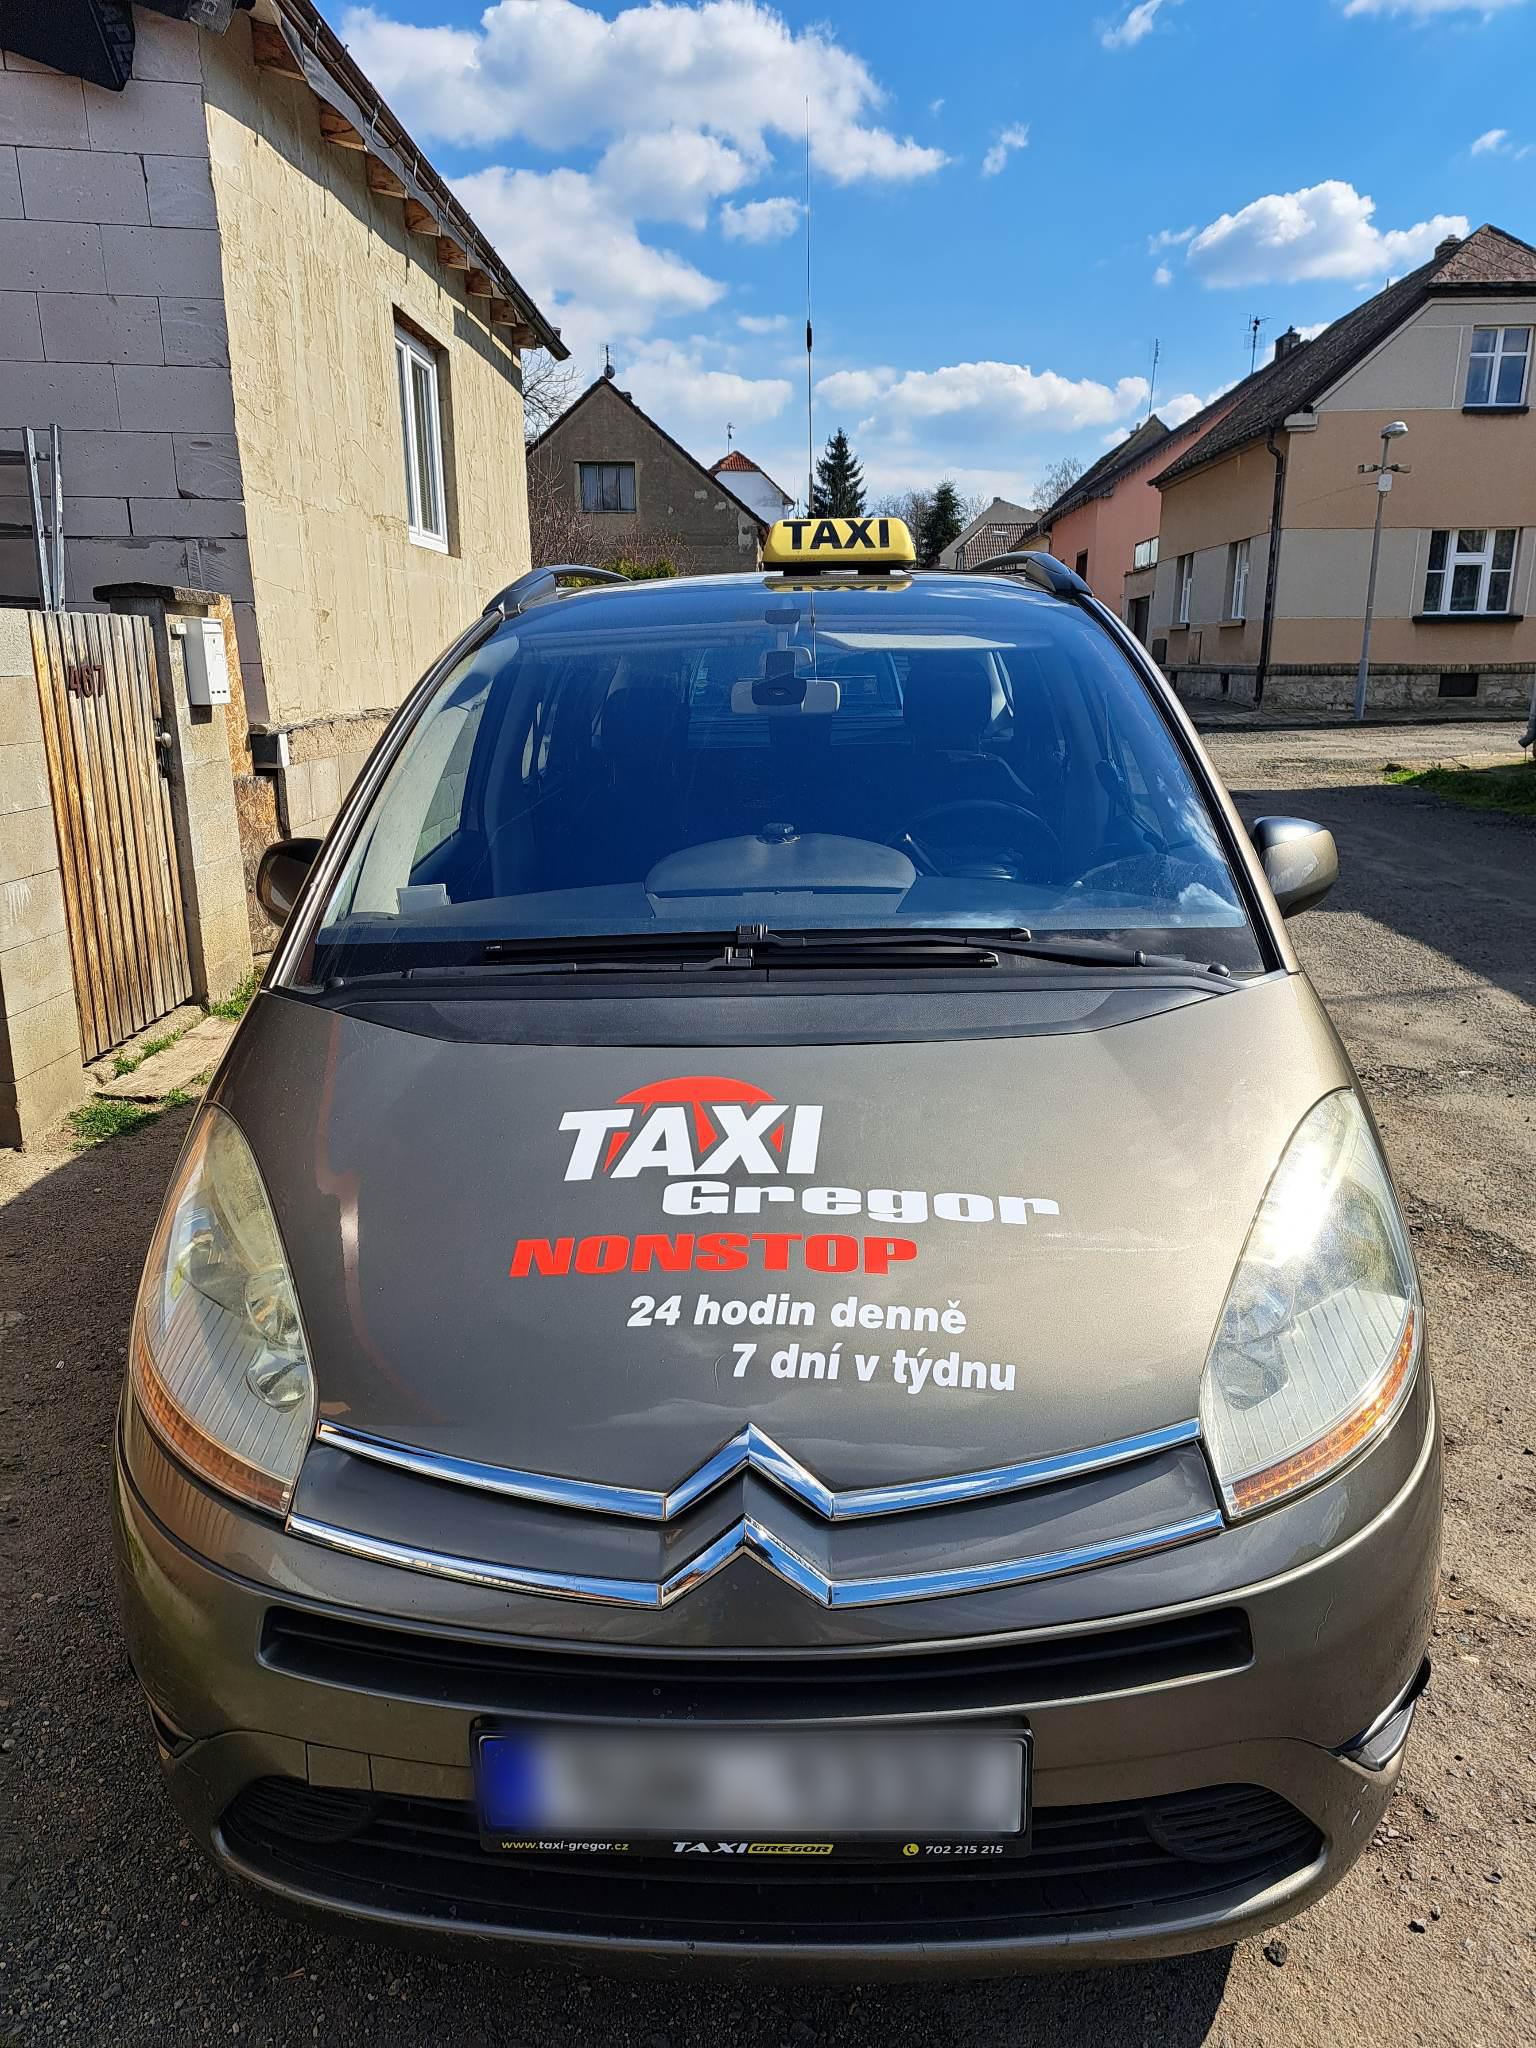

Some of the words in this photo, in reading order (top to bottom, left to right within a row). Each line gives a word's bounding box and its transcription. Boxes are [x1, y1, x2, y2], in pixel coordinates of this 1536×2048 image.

[783, 519, 890, 550] TAXI
[68, 663, 105, 699] 467
[558, 1104, 824, 1182] TAXI
[662, 1180, 1061, 1226] Gregor
[509, 1232, 919, 1278] NONSTOP
[627, 1295, 682, 1327] 24
[693, 1293, 816, 1328] hodin
[830, 1299, 968, 1335] denně
[732, 1343, 759, 1379] 7
[770, 1343, 842, 1381] dní
[854, 1354, 881, 1382] v
[891, 1348, 1018, 1395] týdnu
[501, 1840, 630, 1853] www.taxi-gregor.cz
[672, 1841, 749, 1854] TAXI
[750, 1844, 832, 1854] GREGOR
[925, 1845, 952, 1855] 702
[954, 1845, 978, 1855] 215
[980, 1845, 1004, 1855] 215
